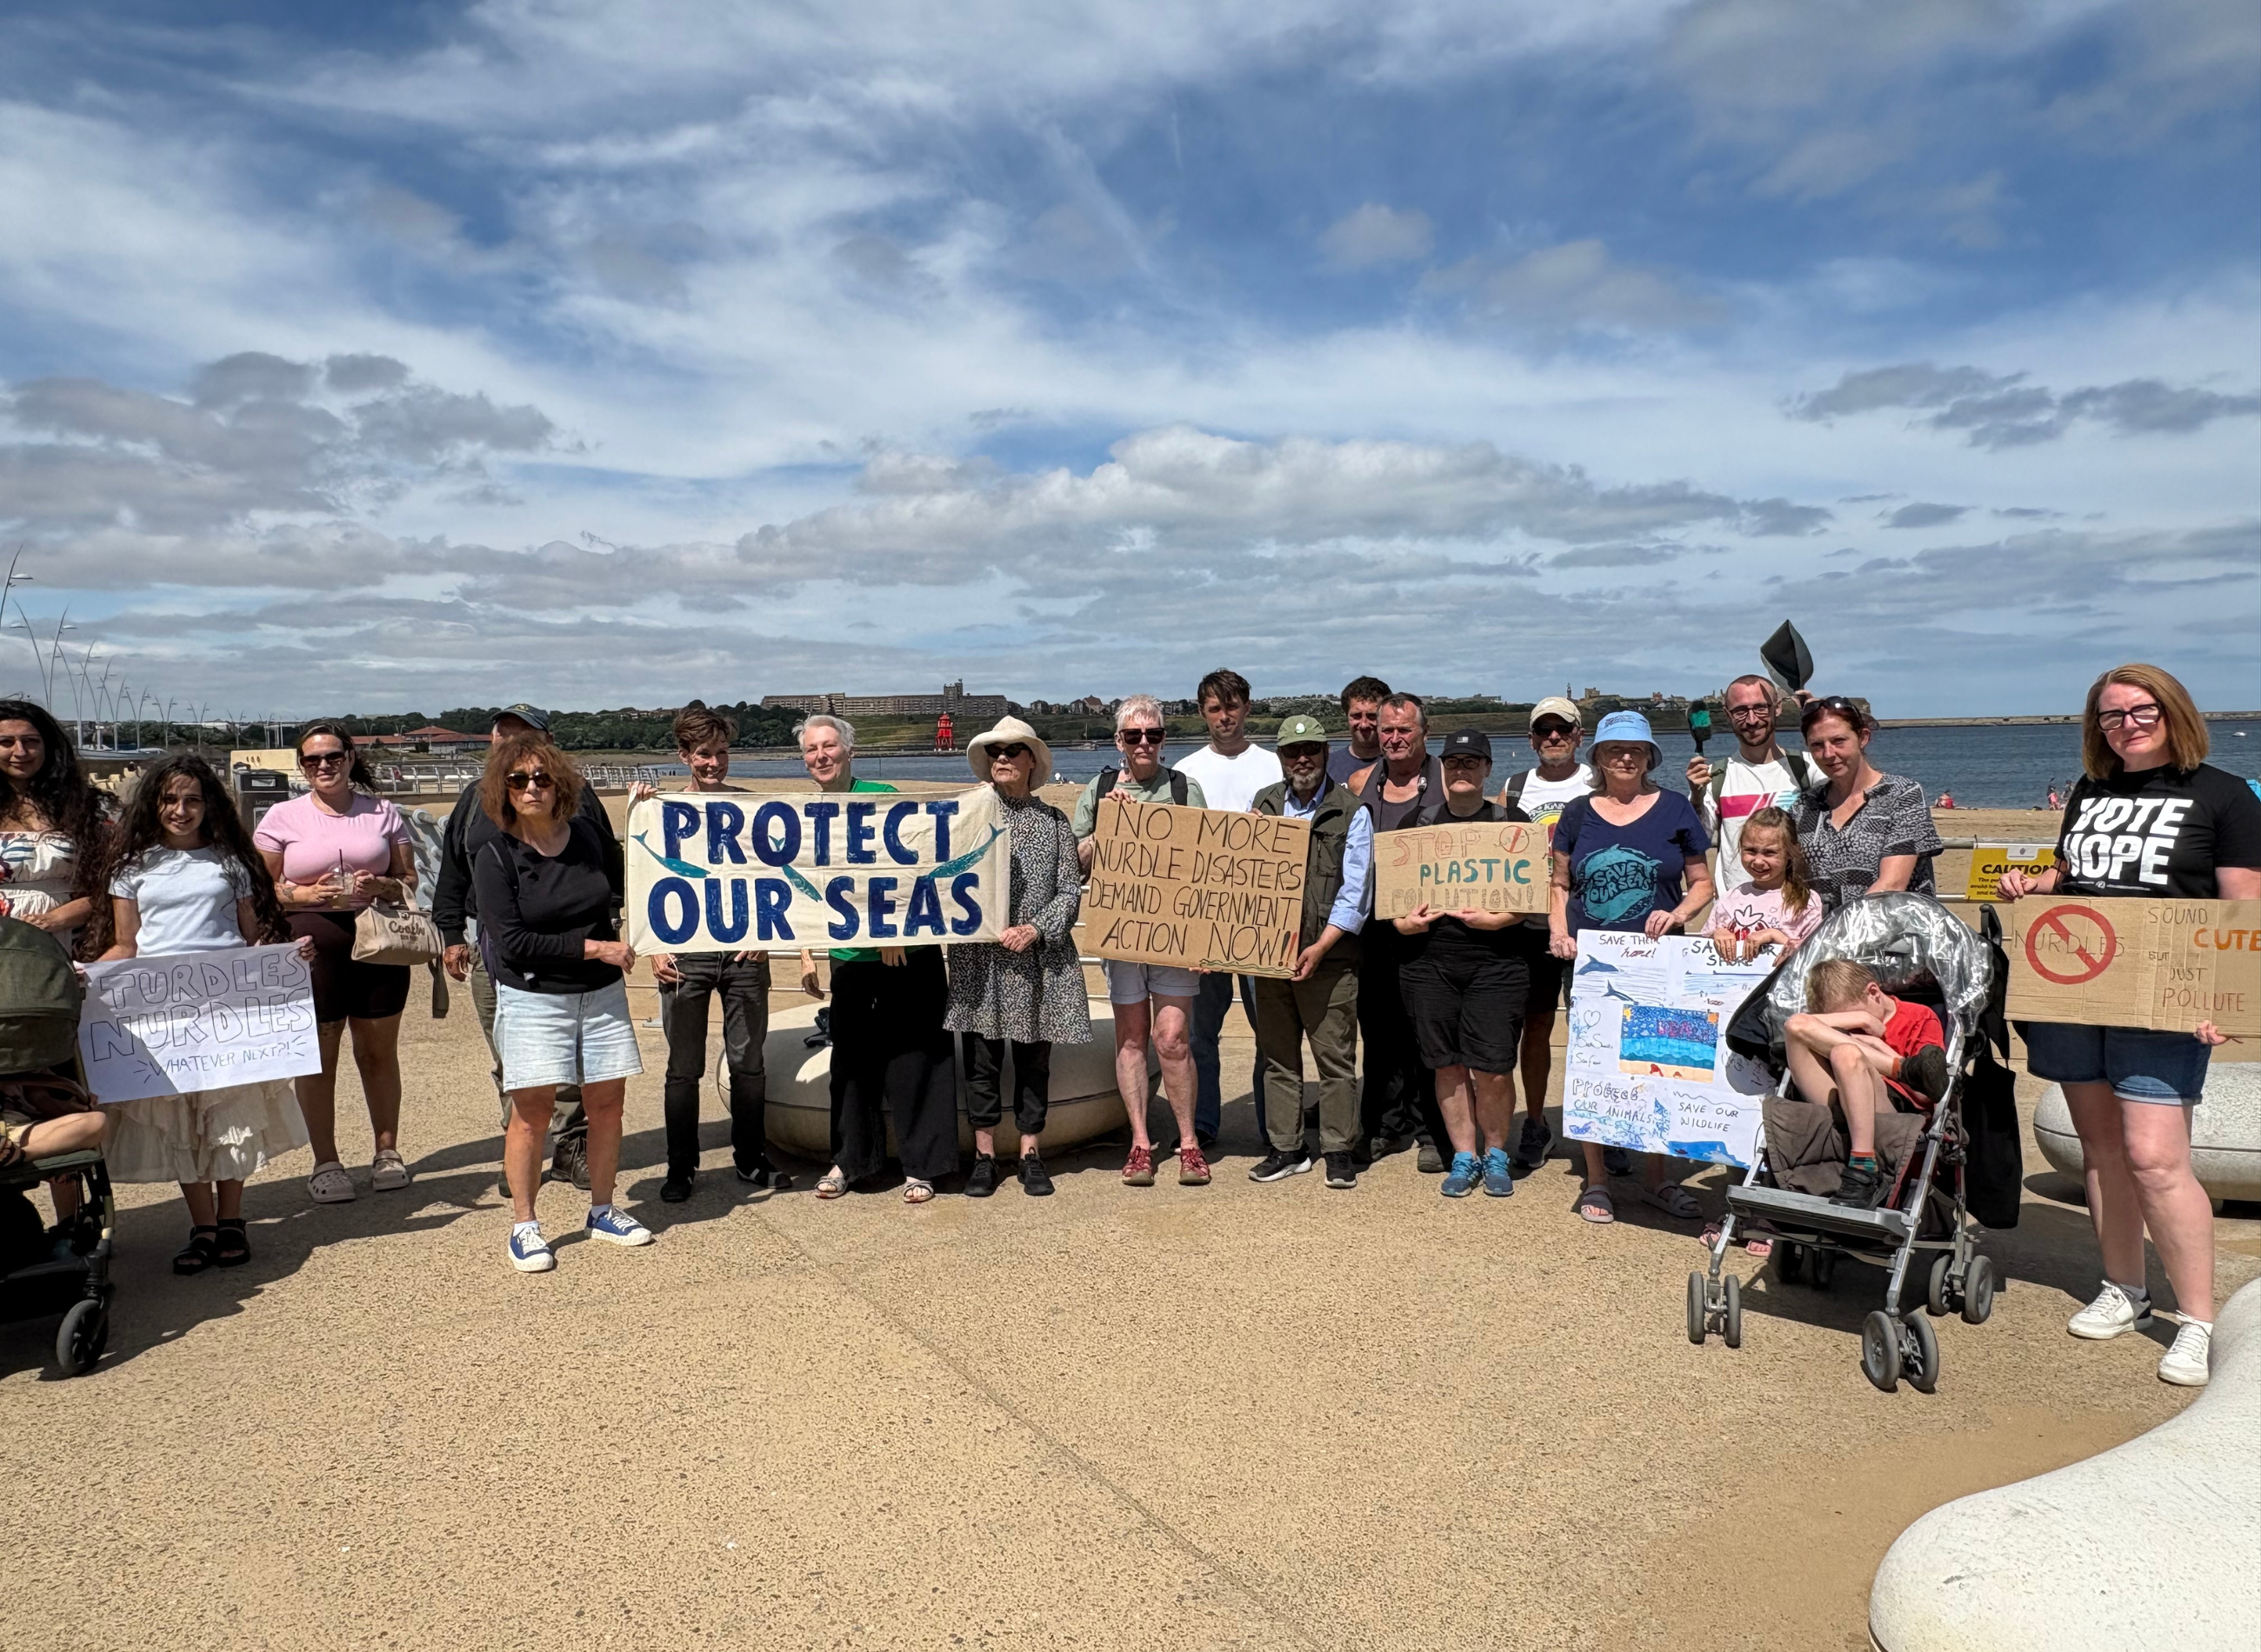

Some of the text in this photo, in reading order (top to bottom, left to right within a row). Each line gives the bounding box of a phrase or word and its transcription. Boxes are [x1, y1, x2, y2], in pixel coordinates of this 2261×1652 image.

[662, 800, 959, 867] PROTECT
[1114, 803, 1302, 854] NO MORE
[1393, 829, 1481, 866] STOP
[1092, 839, 1303, 891] NURDLE DISASTERS
[1420, 858, 1531, 887] PLASTIC
[1593, 862, 1637, 887] SAVE
[1089, 876, 1302, 930] DEMAND GOVERNMENT
[1590, 871, 1651, 903] OUR SEAS
[647, 872, 983, 945] OUR SEAS
[2148, 907, 2209, 925] SOUND
[1101, 916, 1298, 968] ACTION NOW!!
[1599, 934, 1625, 945] SAVE
[2148, 950, 2170, 961] BUT
[100, 948, 307, 1009] TURDLES
[2171, 967, 2208, 981] JUST
[2162, 988, 2244, 1012] POLLUTE
[90, 987, 313, 1062] NURDLES
[150, 1043, 290, 1076] WHATEVER NEXT?!
[1573, 1099, 1598, 1110] OUR
[1678, 1102, 1738, 1118] SAVE OUR
[1681, 1116, 1731, 1131] WILDLIFE
